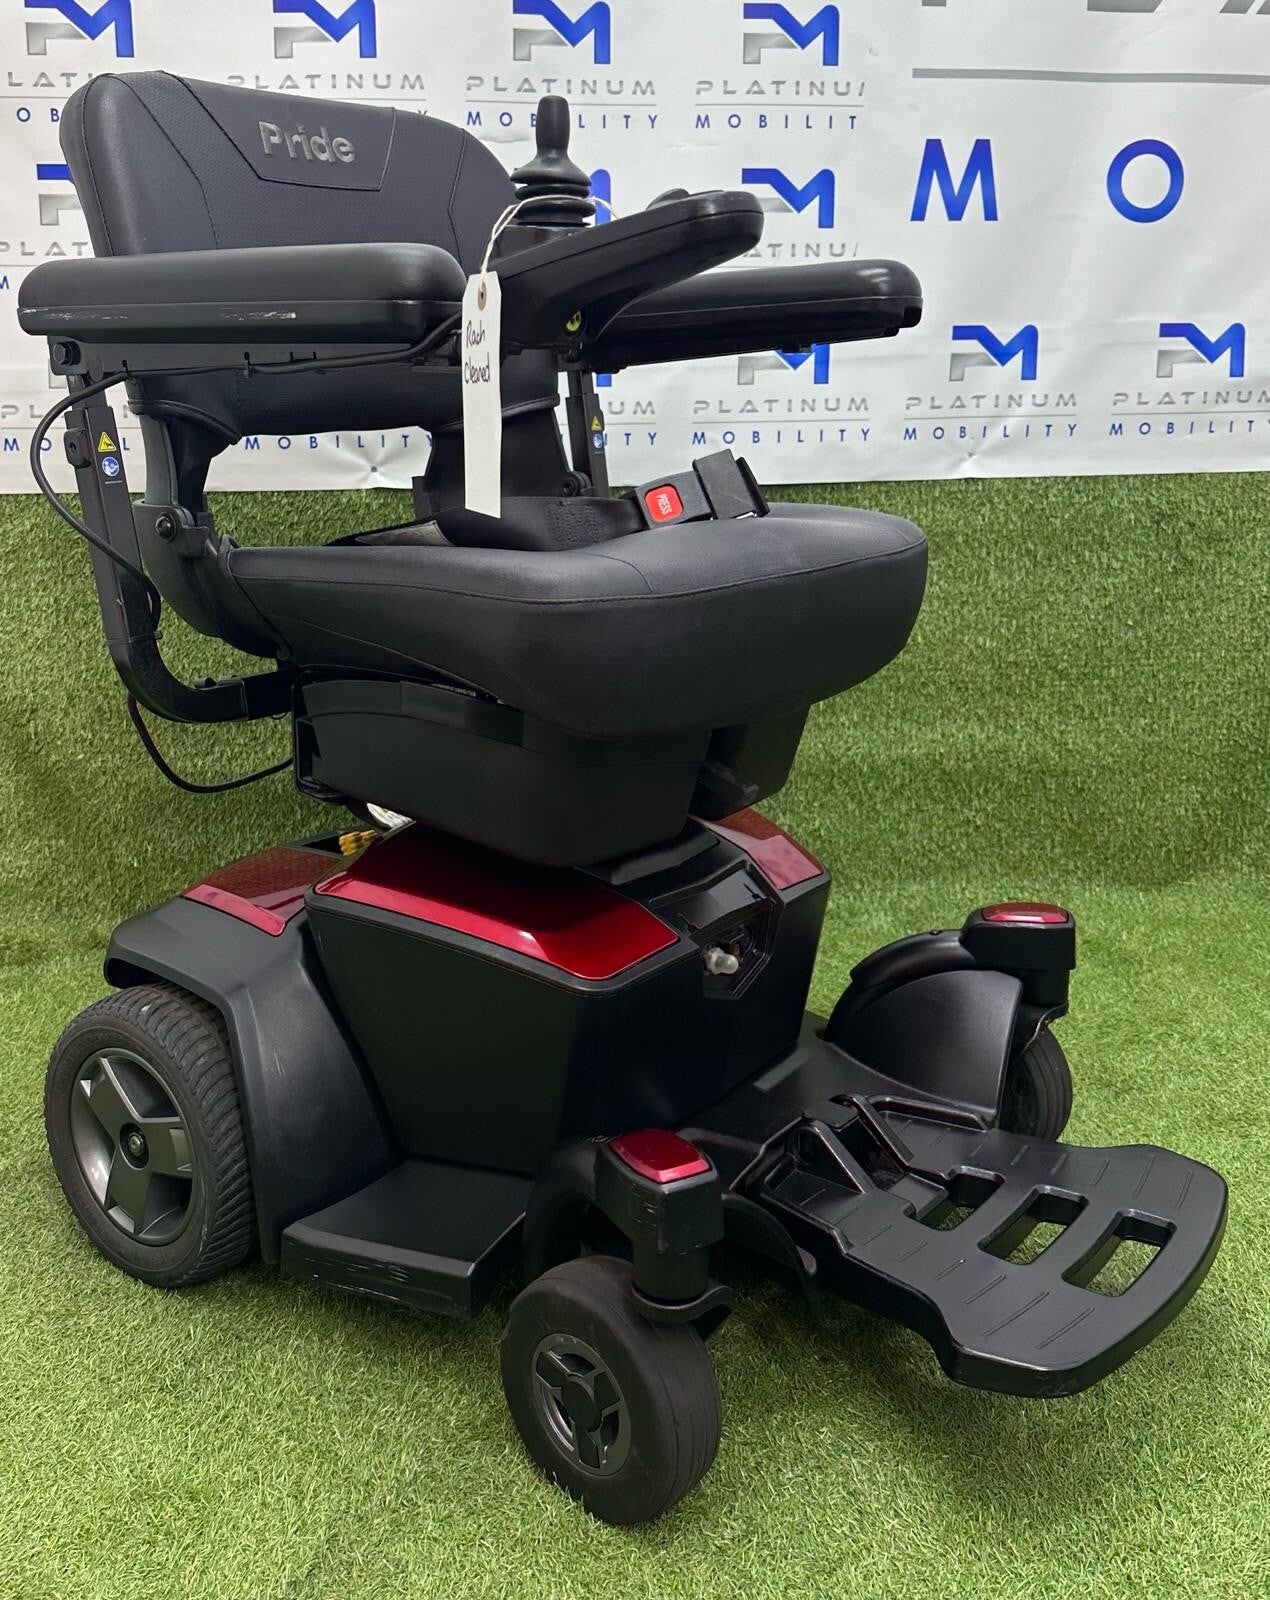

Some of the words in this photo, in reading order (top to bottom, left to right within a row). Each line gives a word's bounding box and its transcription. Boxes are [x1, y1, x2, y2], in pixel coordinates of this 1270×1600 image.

[466, 76, 656, 95] PLATINUM
[466, 111, 658, 129] MOBLITY
[259, 121, 355, 163] Pride
[693, 396, 869, 415] PLATINUM
[905, 393, 1077, 410] PLATINUM
[692, 427, 870, 446] MOBILITY
[904, 422, 1078, 441] MOBILITY
[1109, 419, 1270, 436] MOBILIT
